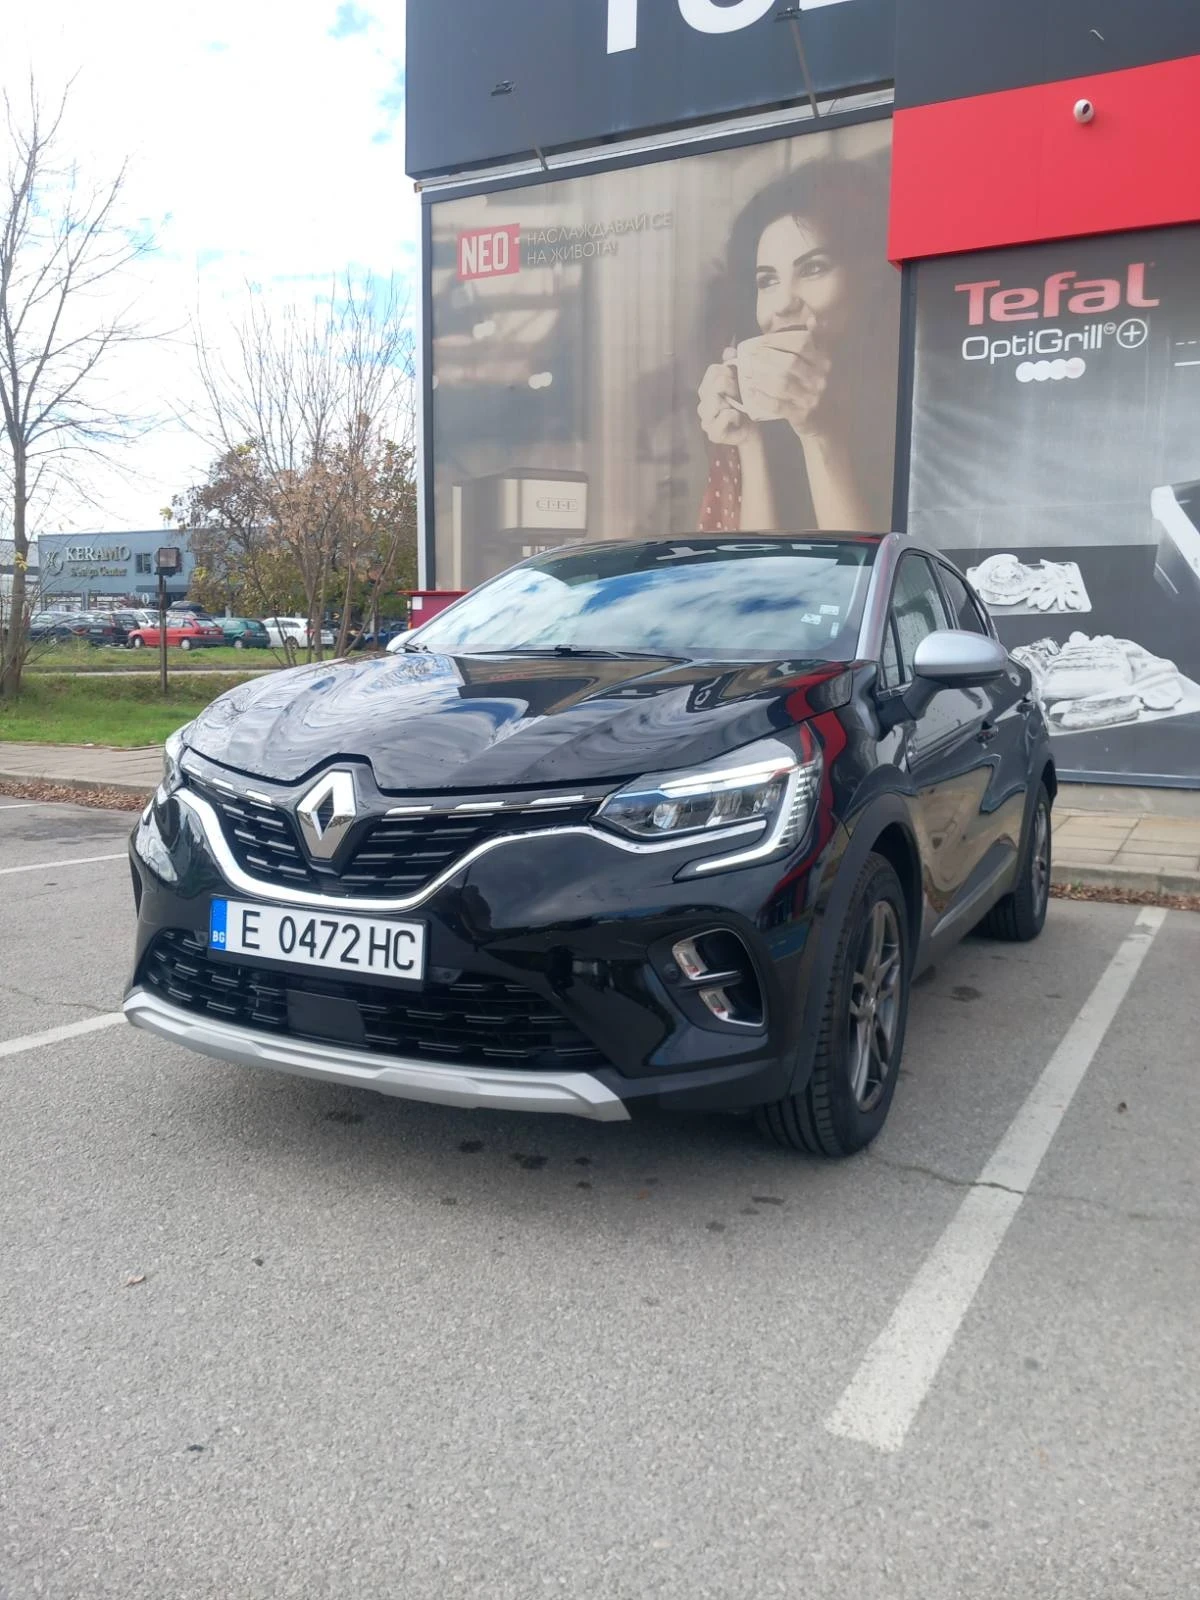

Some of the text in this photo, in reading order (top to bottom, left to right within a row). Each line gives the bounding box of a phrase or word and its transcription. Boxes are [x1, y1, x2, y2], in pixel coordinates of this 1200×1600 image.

[527, 212, 673, 246] НАСЛАЖДАВАЙ СЕ
[461, 231, 509, 276] NEO
[527, 252, 547, 266] НА
[954, 262, 1160, 326] Tefal
[961, 323, 1103, 365] OptiGrill
[65, 546, 132, 562] KERAMO
[212, 930, 226, 944] BG
[241, 909, 261, 950] E
